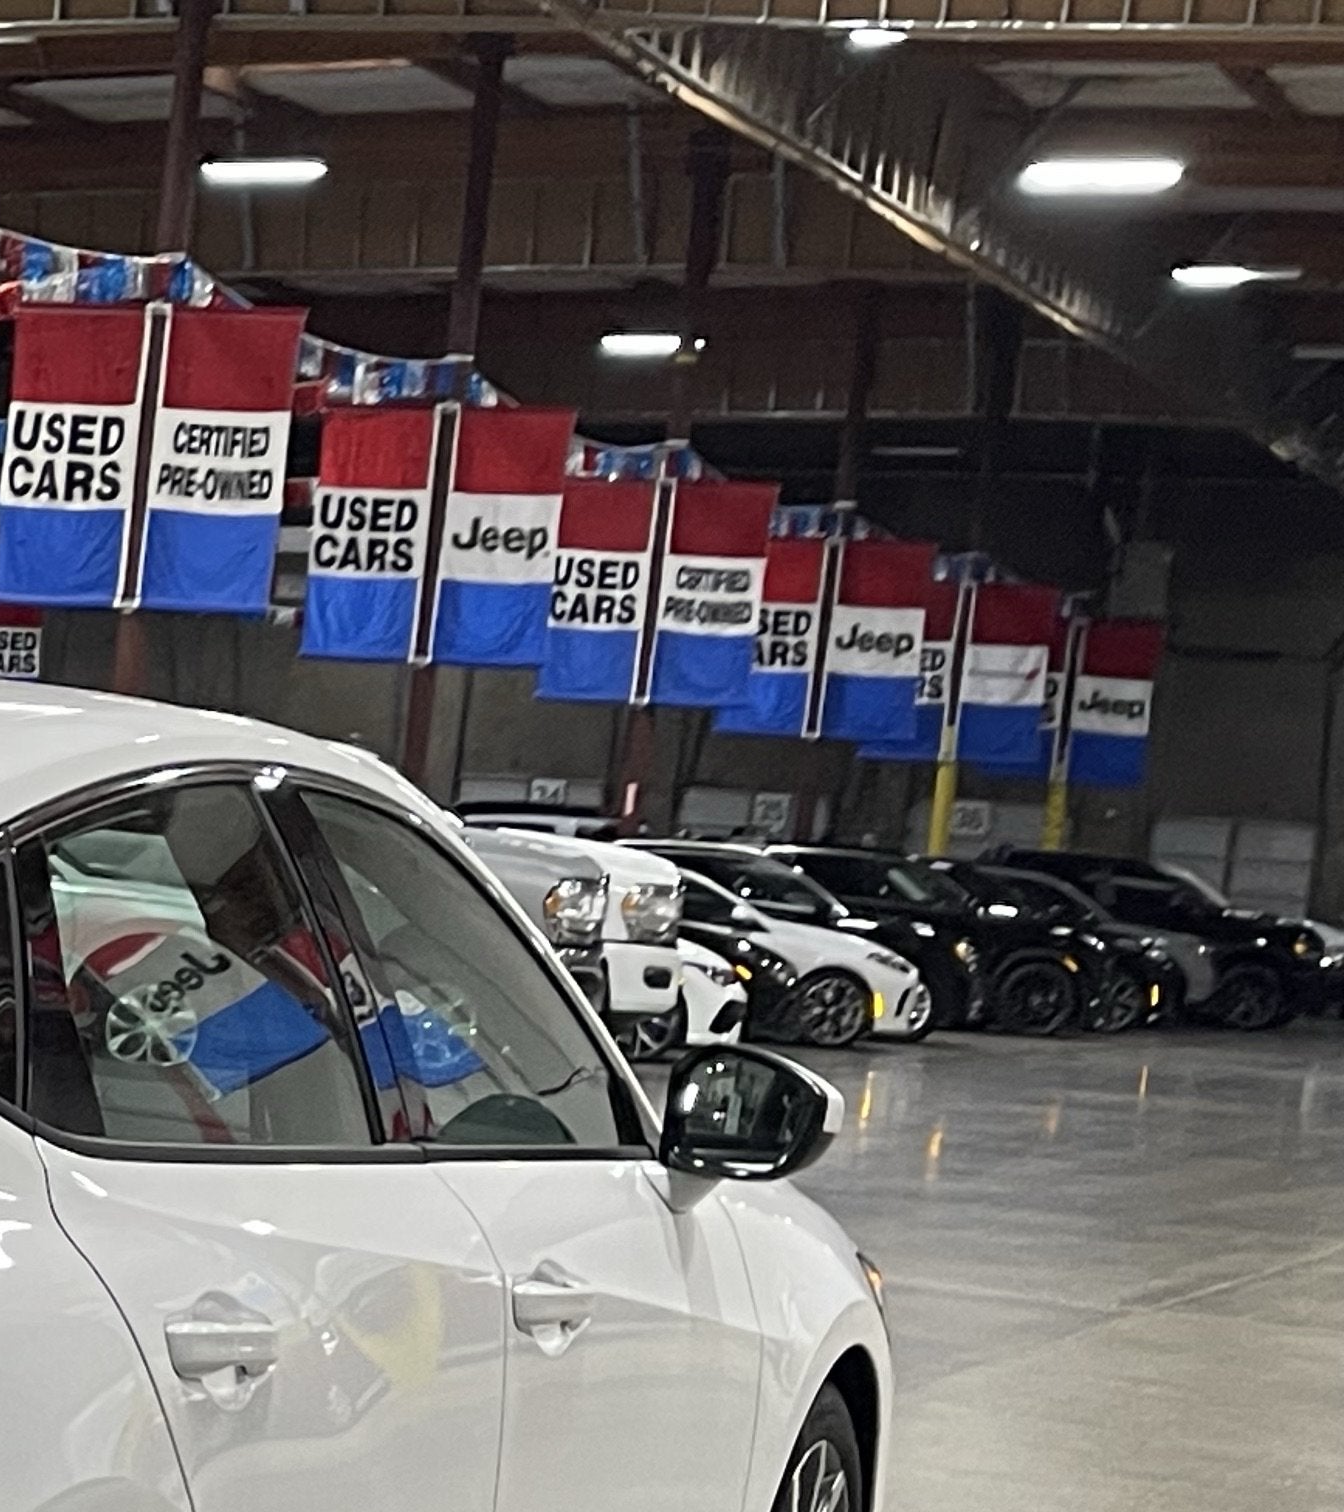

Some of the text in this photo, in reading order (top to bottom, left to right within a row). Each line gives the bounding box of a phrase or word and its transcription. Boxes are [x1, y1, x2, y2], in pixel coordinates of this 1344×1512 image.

[13, 410, 125, 456] USED
[173, 421, 270, 458] CERTIFIED
[8, 456, 121, 501] CARS
[156, 463, 272, 500] PRE-OWNED
[320, 494, 418, 533] USED
[314, 534, 414, 572] CARS
[452, 516, 548, 561] Jeep
[554, 555, 640, 590] USED
[551, 590, 637, 624] CARS
[757, 608, 811, 637] SED
[835, 622, 914, 659] Jeep
